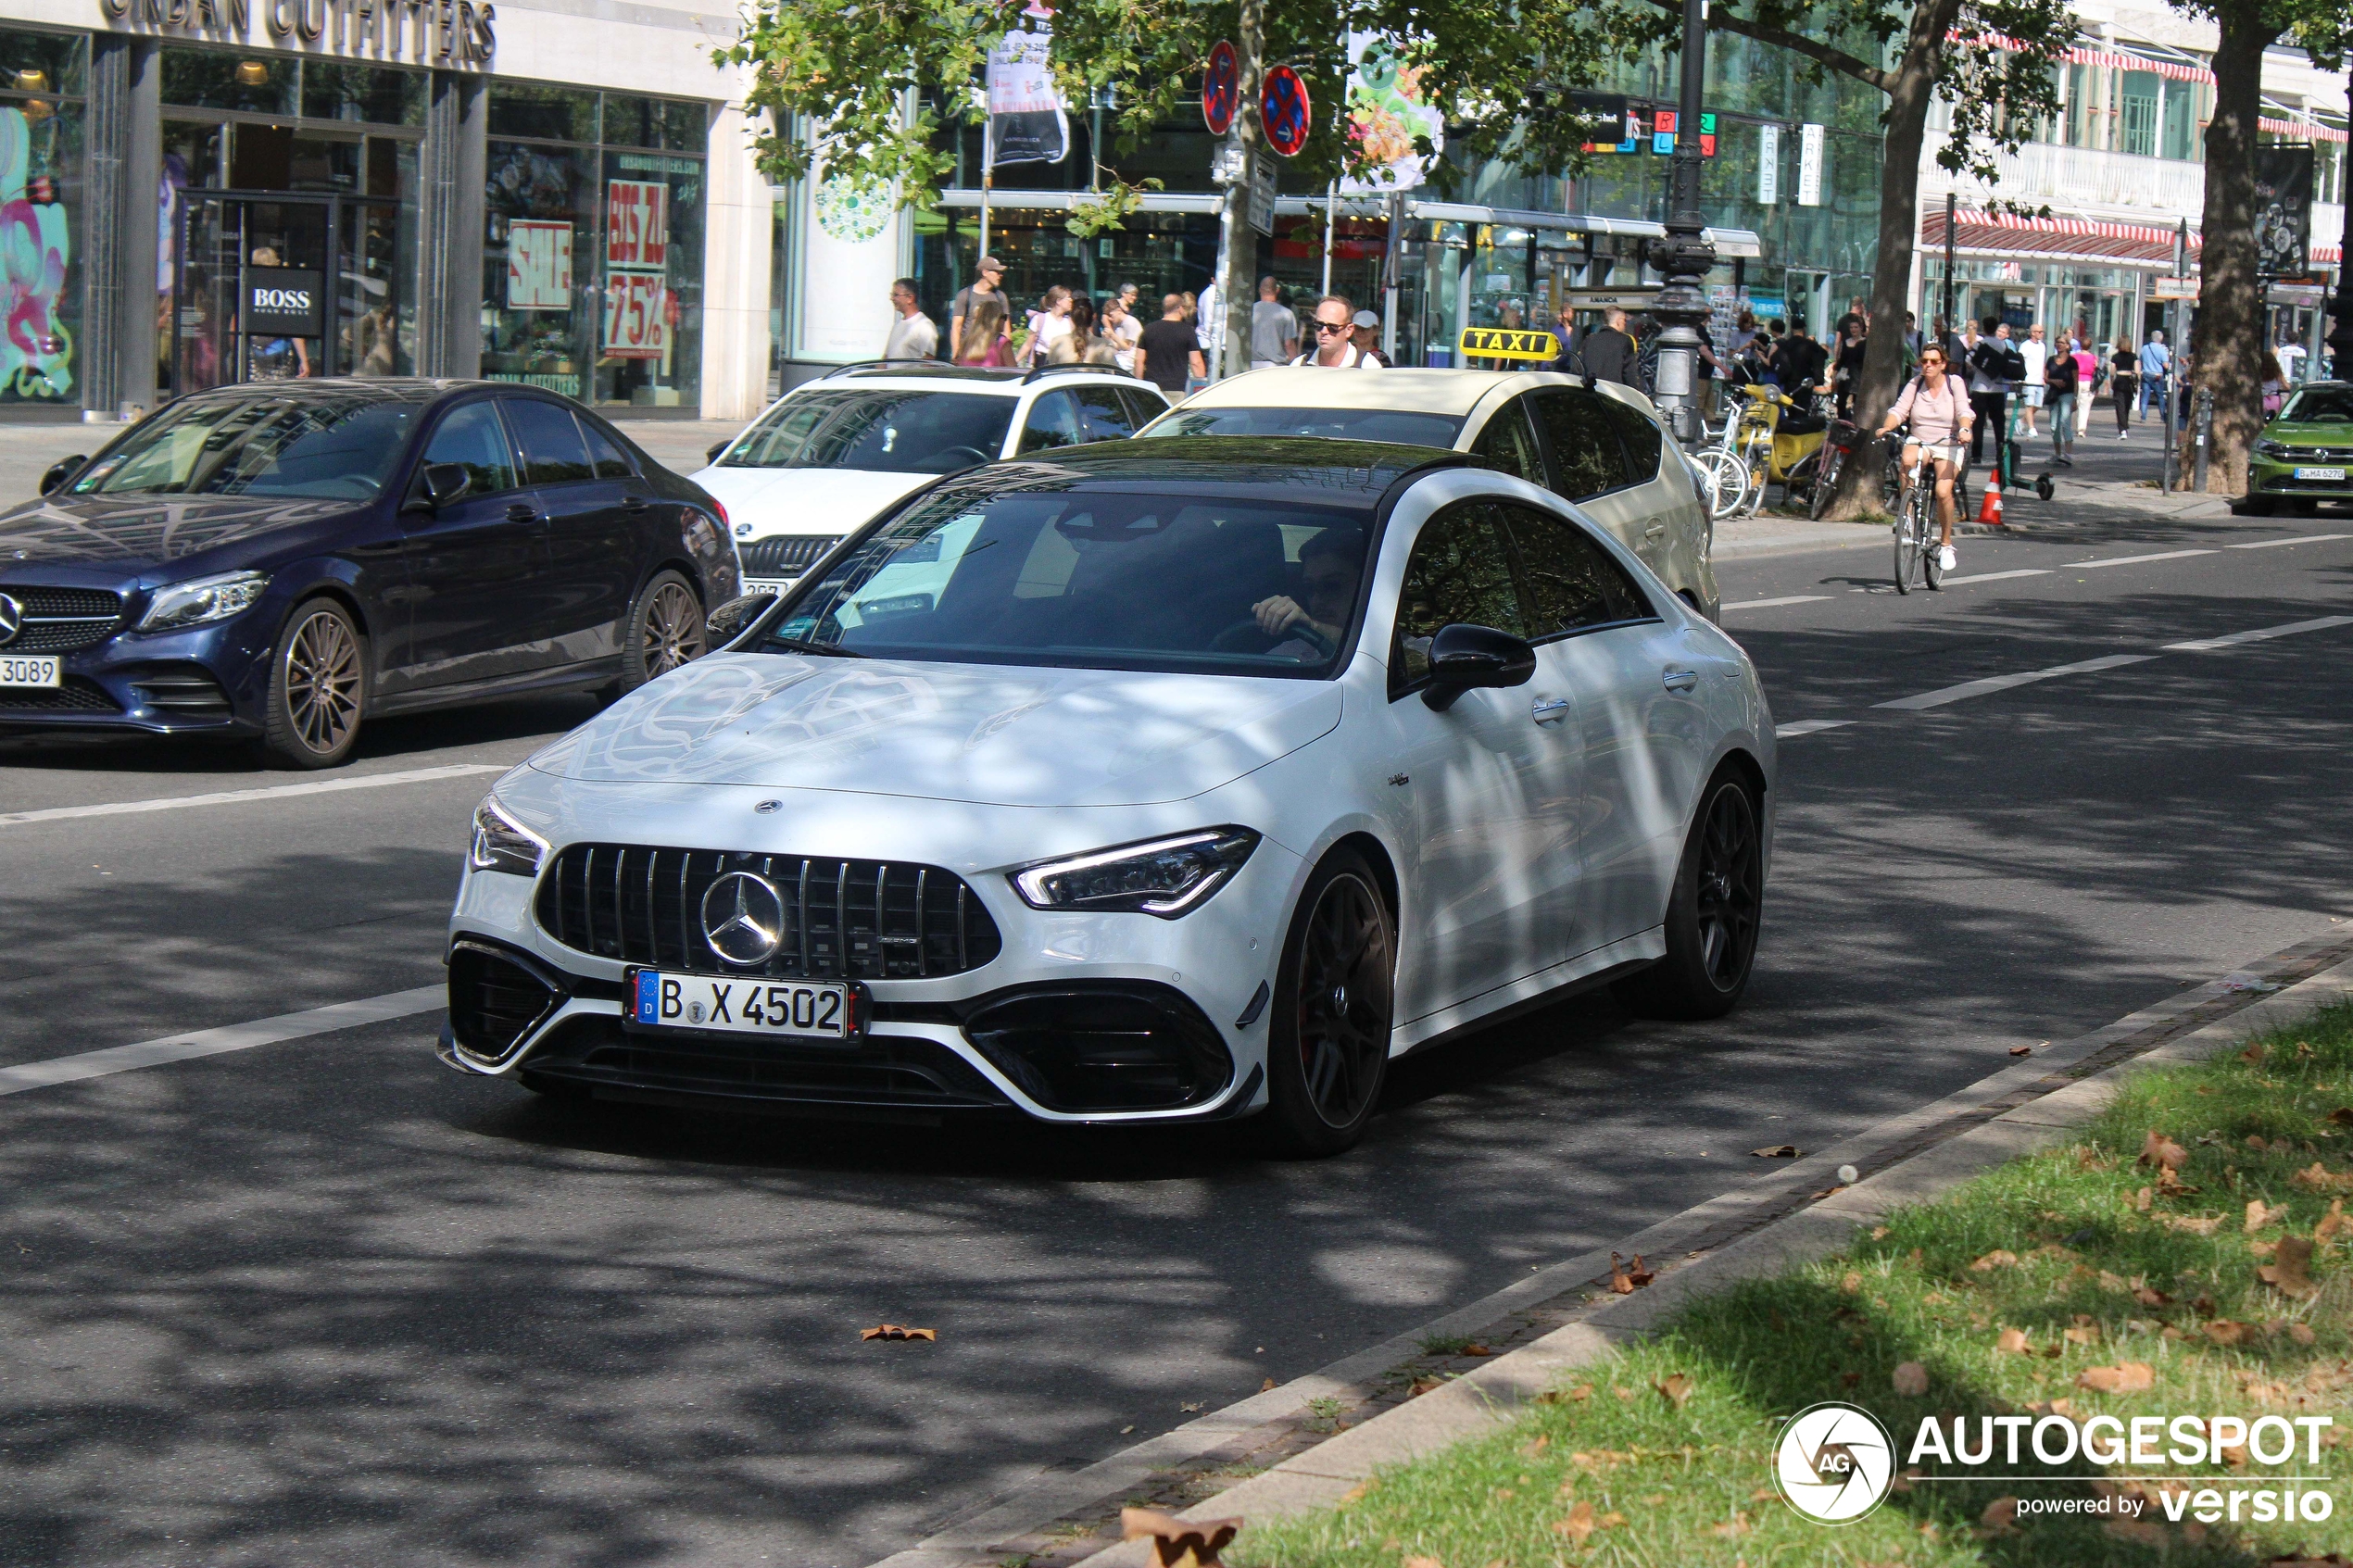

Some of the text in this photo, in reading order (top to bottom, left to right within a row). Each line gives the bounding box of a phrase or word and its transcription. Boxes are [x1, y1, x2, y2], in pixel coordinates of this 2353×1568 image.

[265, 0, 497, 62] OUTFITTERS
[1803, 127, 1816, 202] ARKET
[608, 182, 668, 265] BIS ZU
[510, 227, 570, 306] SALE
[254, 288, 311, 308] BOSS
[606, 275, 663, 345] -75%
[1474, 332, 1537, 351] TAXI
[2, 660, 54, 683] 3089
[644, 979, 841, 1031] D B X 4502
